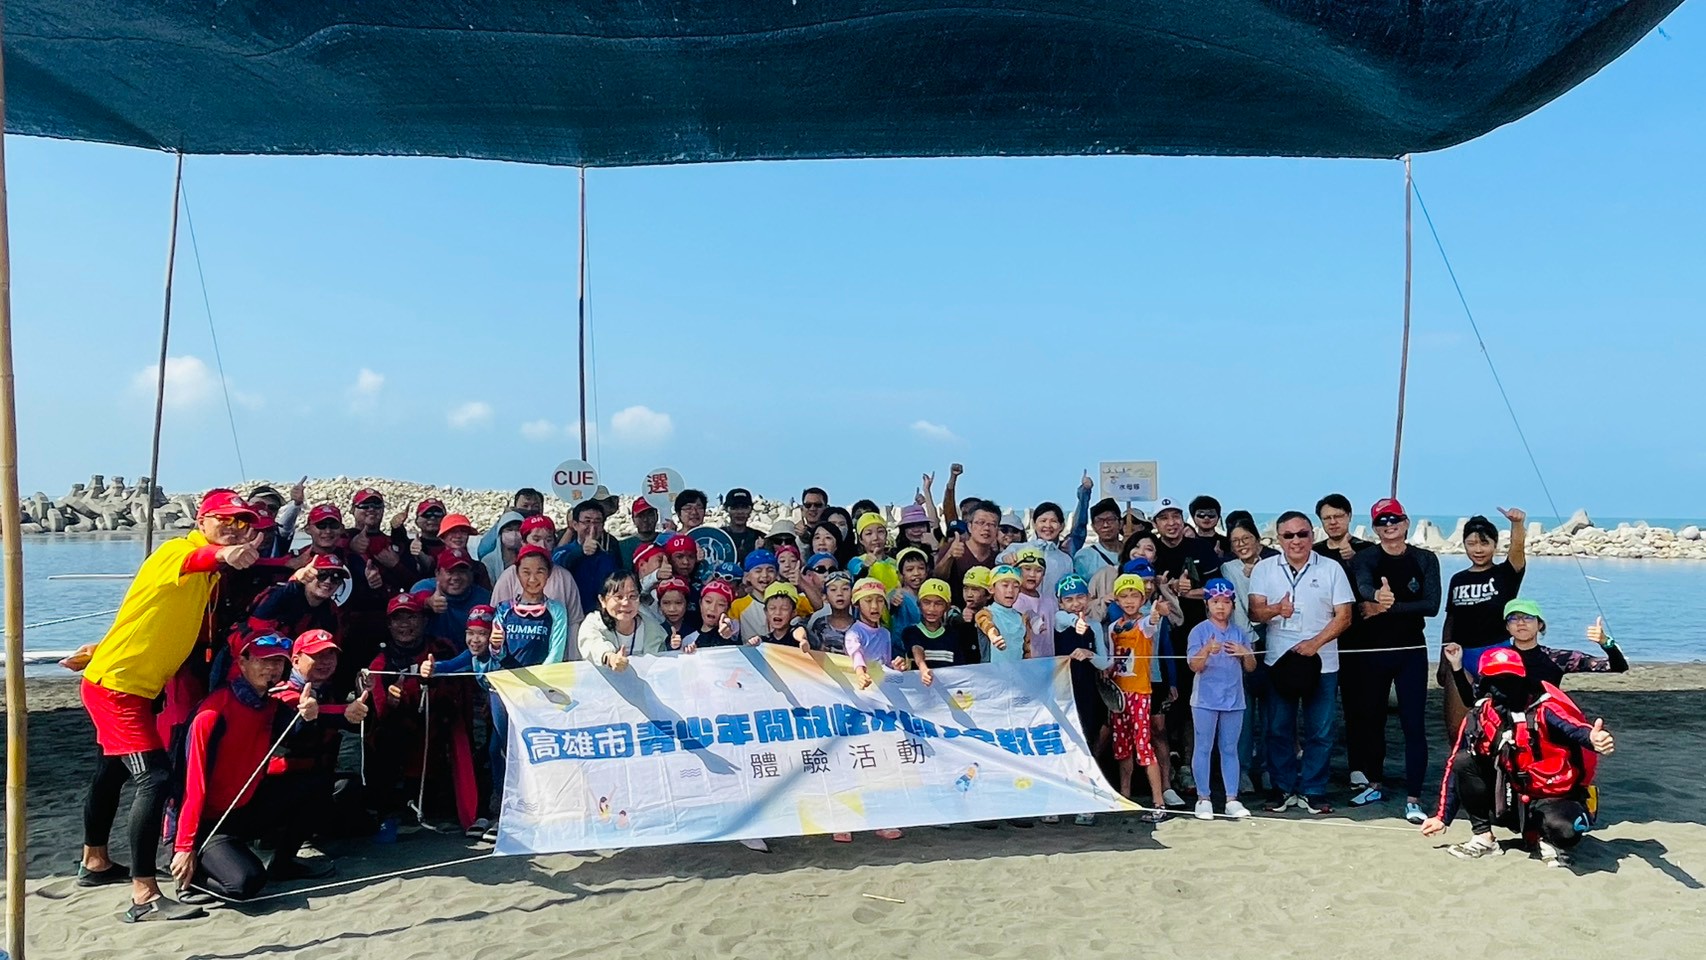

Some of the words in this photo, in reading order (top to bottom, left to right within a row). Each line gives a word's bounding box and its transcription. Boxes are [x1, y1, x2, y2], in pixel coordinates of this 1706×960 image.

[554, 470, 595, 486] CUE
[646, 473, 669, 494] 選
[673, 538, 685, 547] 07
[931, 583, 944, 593] 10
[506, 624, 549, 636] SUMMER
[750, 737, 926, 779] 體驗活動
